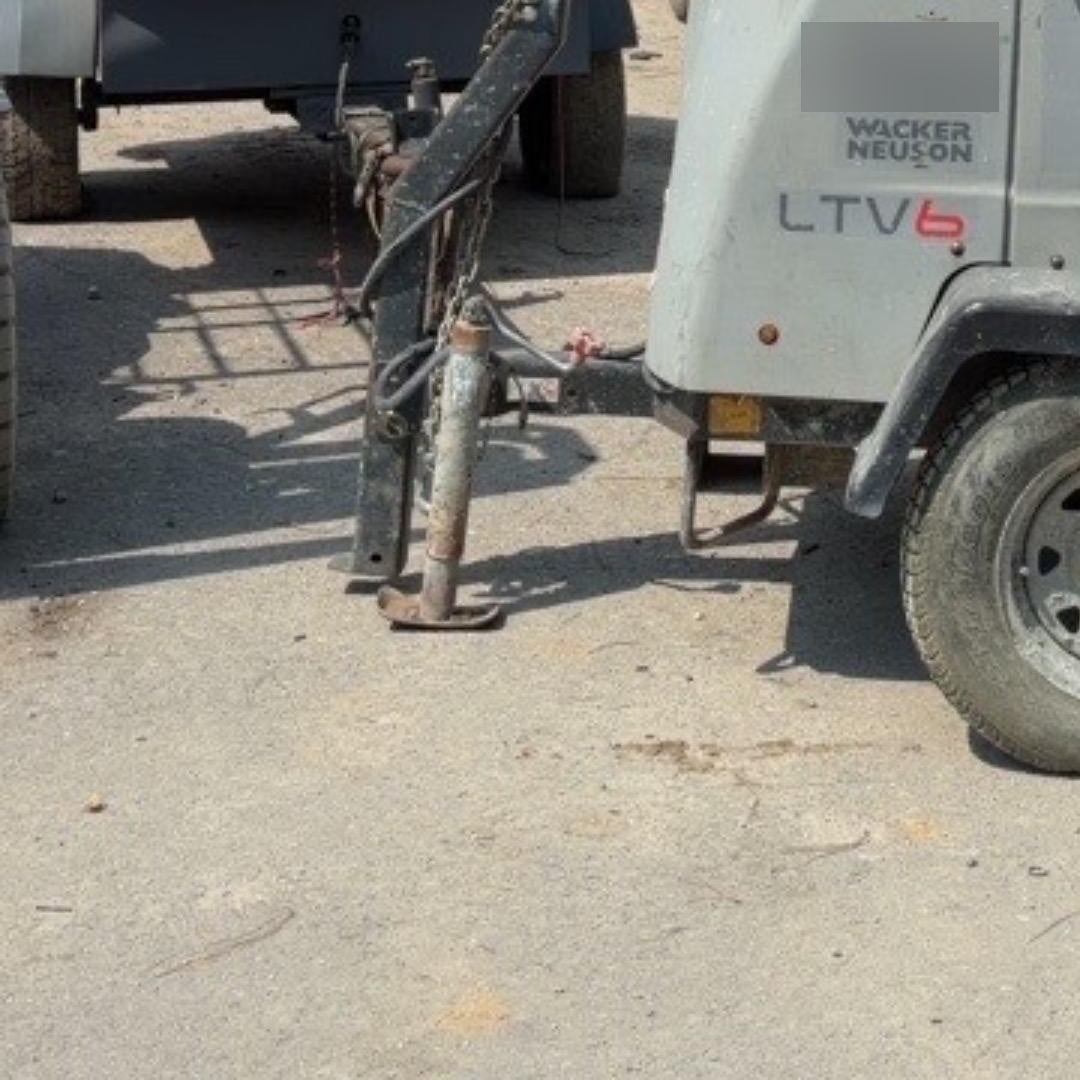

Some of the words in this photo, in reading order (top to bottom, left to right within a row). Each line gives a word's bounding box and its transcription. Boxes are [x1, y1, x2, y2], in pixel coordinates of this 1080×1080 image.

[846, 117, 973, 141] WACKER
[847, 140, 973, 163] NEUSON
[779, 193, 965, 238] LTV6
